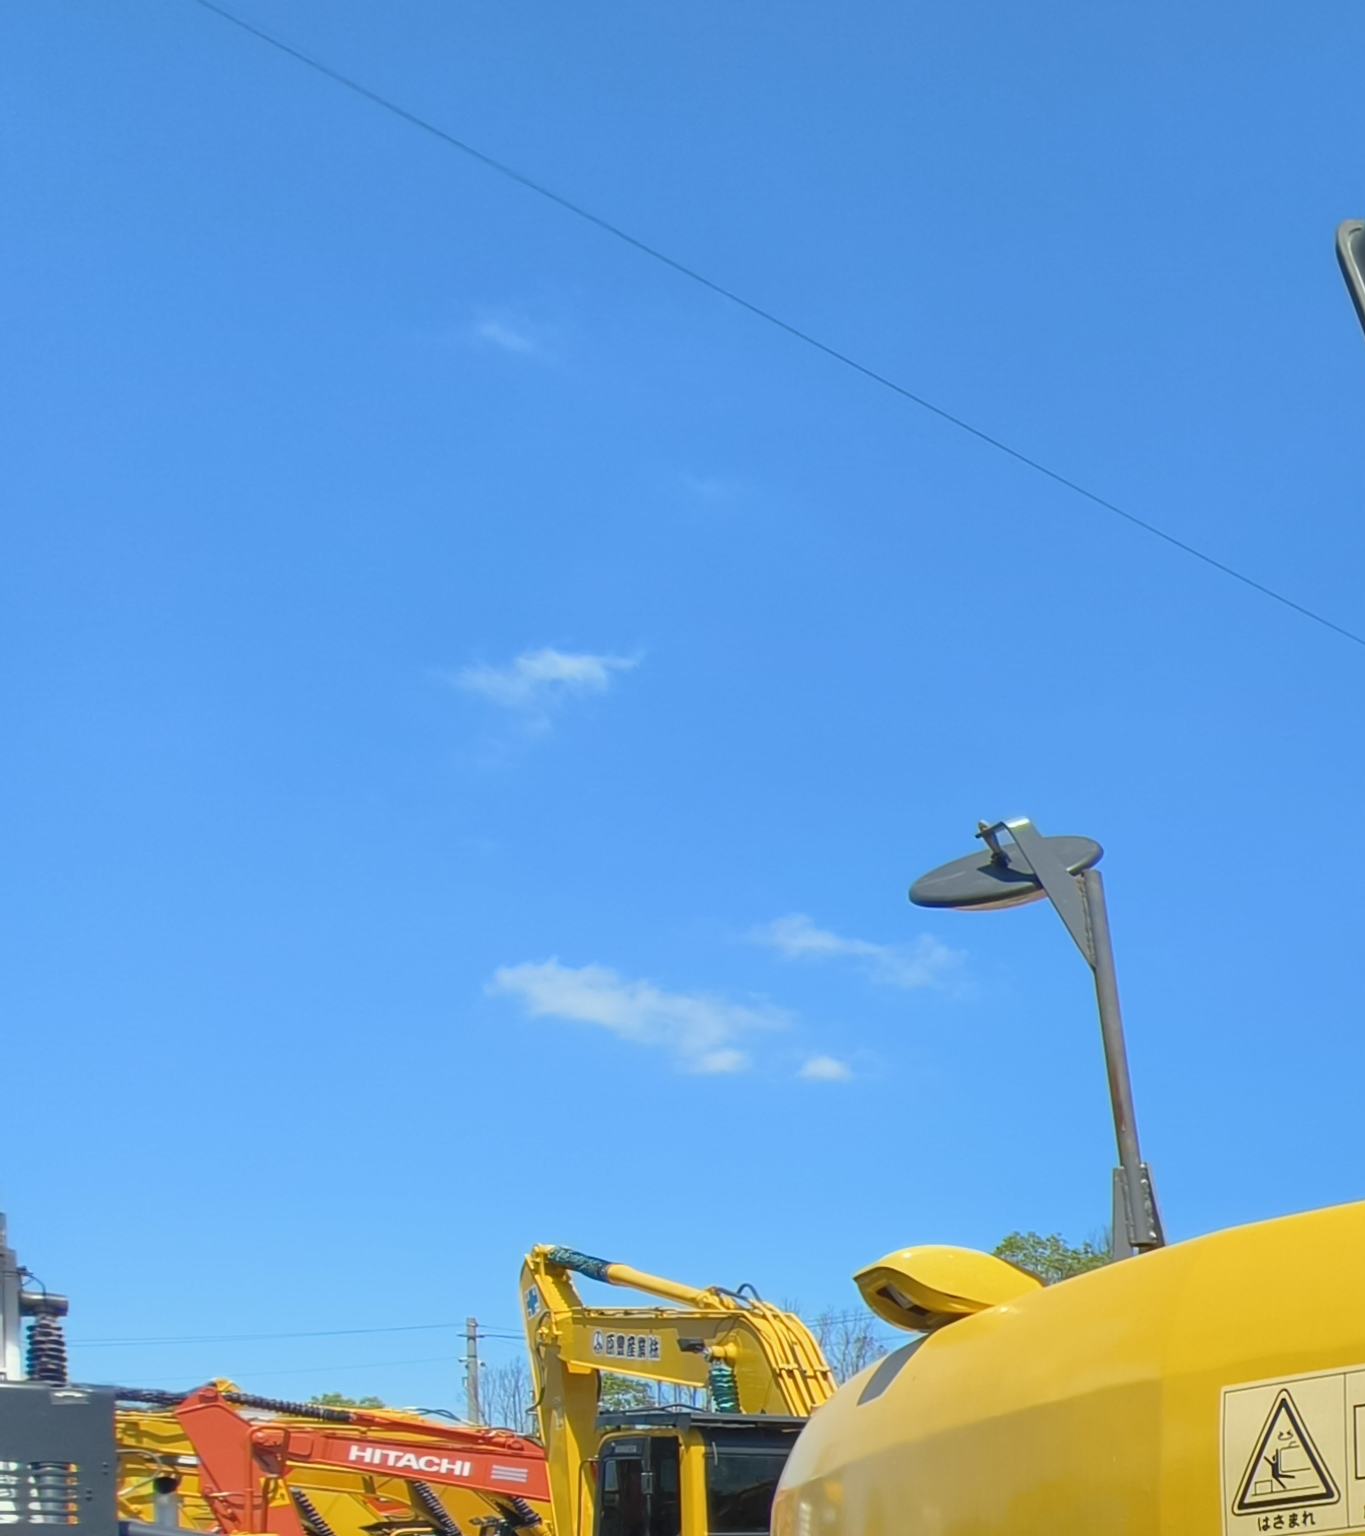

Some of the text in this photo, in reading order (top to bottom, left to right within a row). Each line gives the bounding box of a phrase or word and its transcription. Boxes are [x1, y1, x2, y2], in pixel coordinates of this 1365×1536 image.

[348, 1445, 472, 1477] HITACHI
[1257, 1510, 1316, 1532] はさまれ
